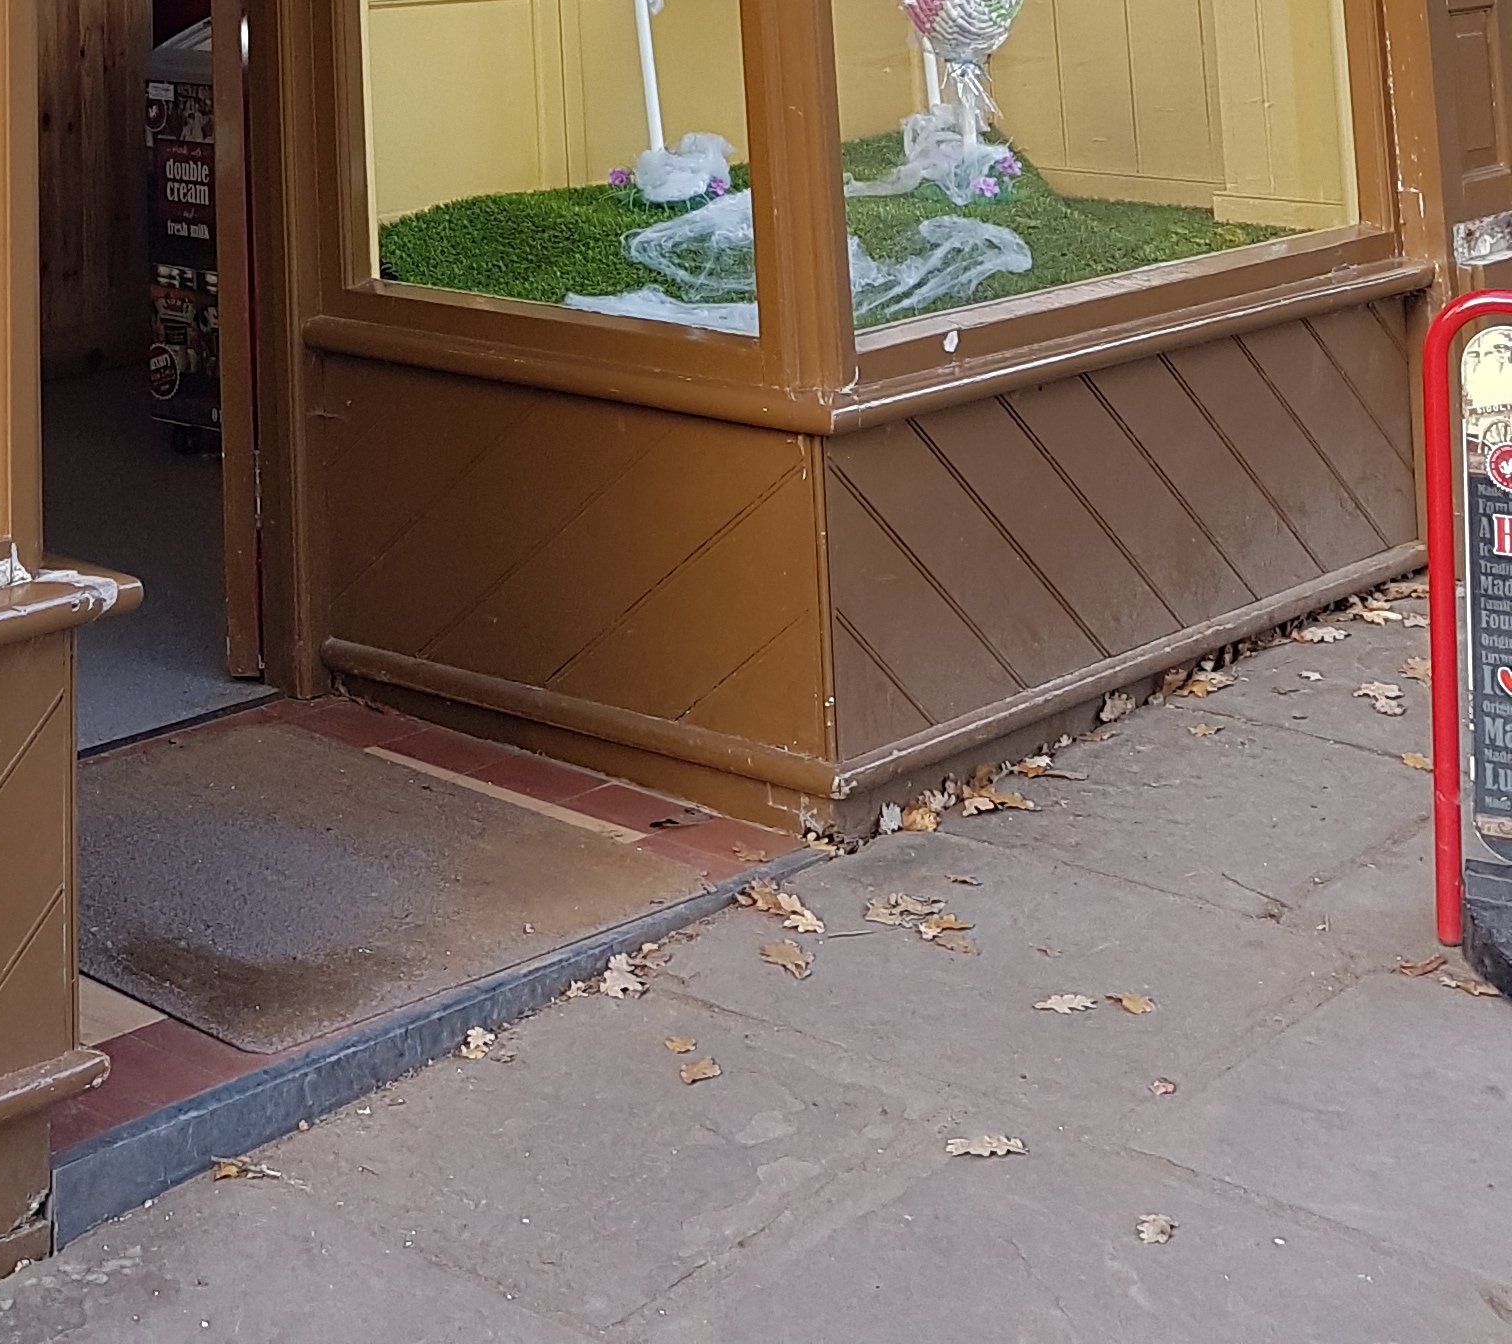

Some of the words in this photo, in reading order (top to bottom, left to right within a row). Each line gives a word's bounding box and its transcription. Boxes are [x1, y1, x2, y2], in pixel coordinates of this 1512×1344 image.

[165, 158, 210, 183] double
[166, 181, 210, 205] cream
[167, 219, 188, 237] fresh
[190, 223, 210, 240] milk
